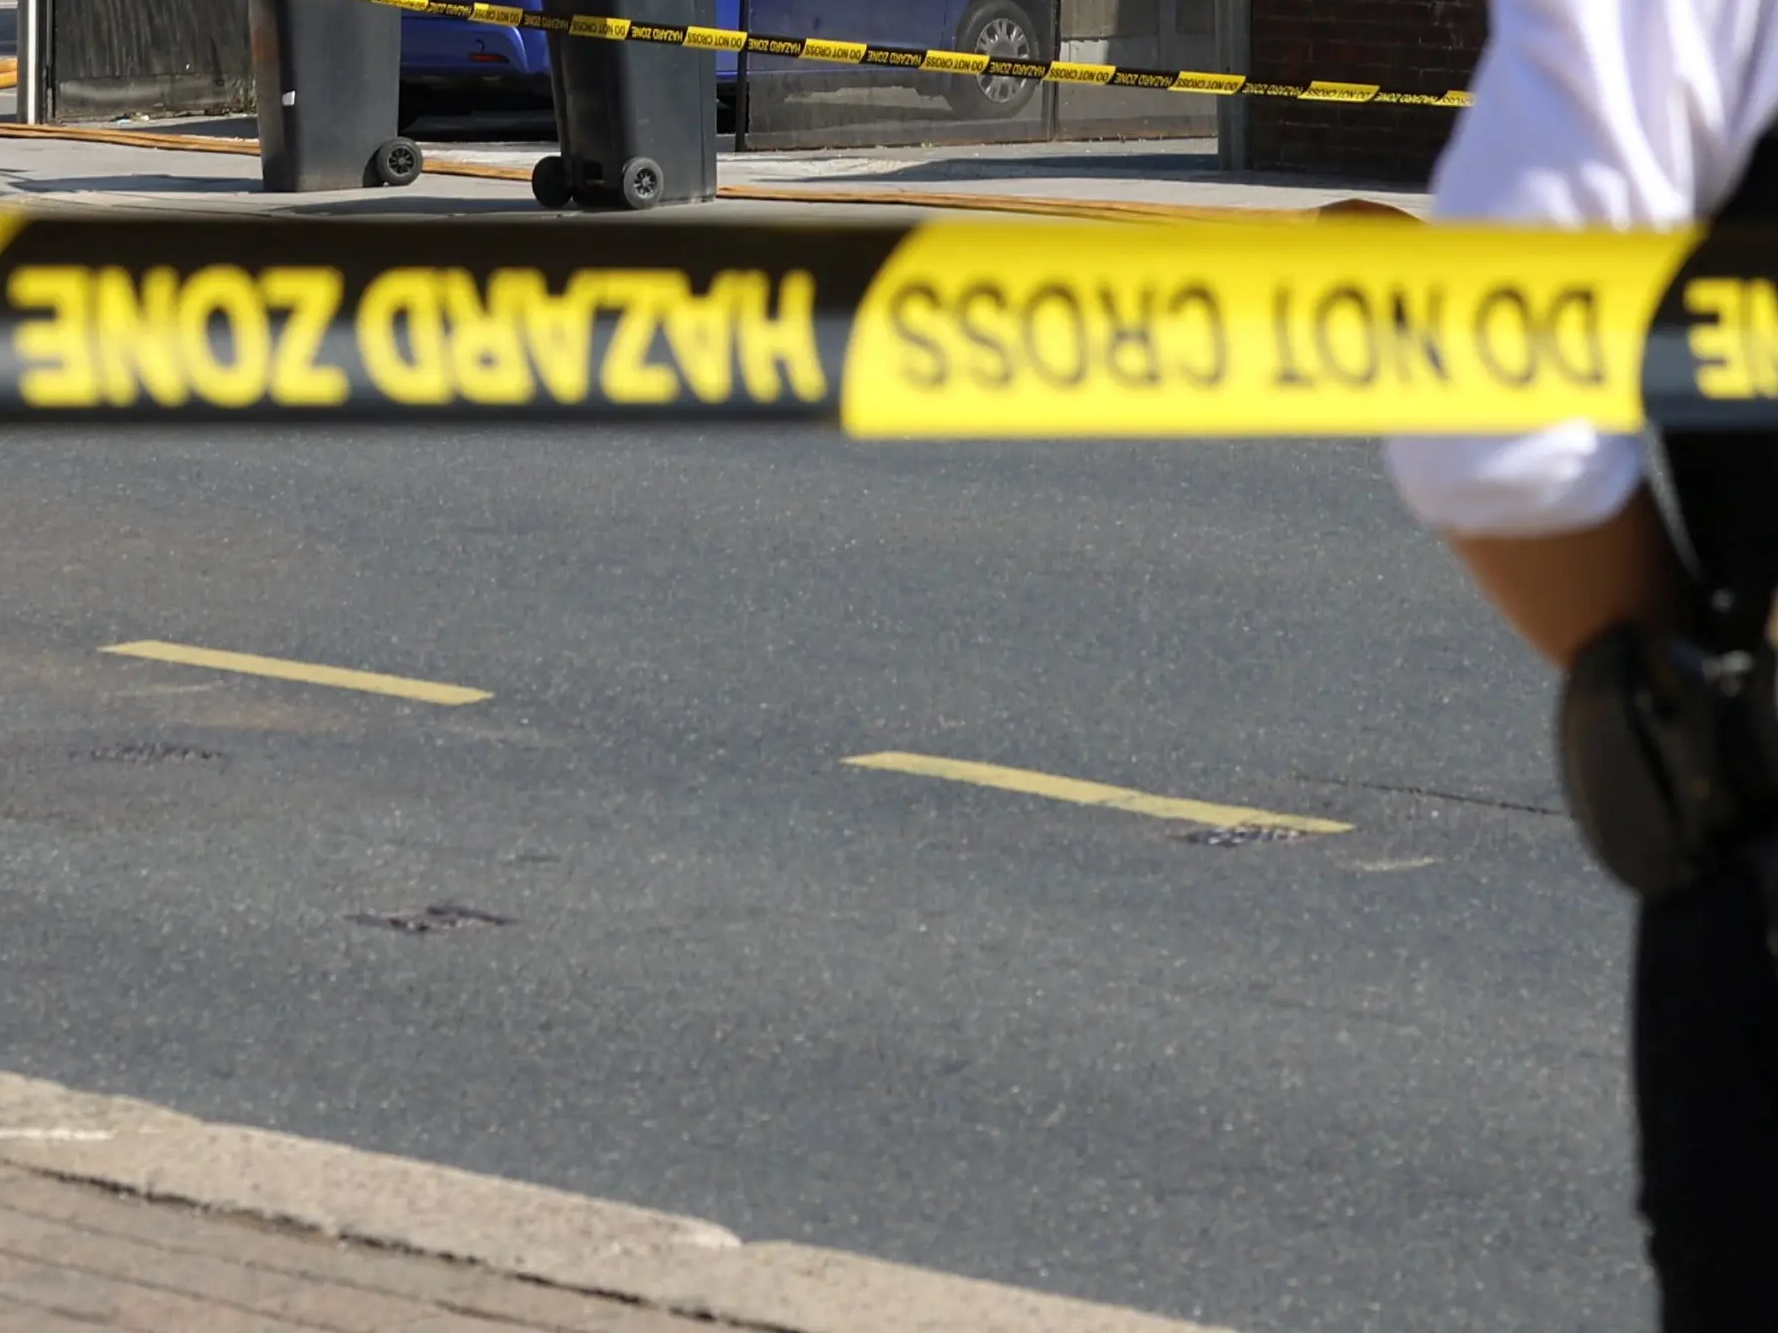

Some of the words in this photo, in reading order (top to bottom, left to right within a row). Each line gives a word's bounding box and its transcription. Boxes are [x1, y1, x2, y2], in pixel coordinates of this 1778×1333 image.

[524, 15, 541, 26] ZONE
[542, 17, 569, 29] HAZARD
[572, 20, 598, 32] CROSS
[599, 23, 614, 34] NOT
[615, 24, 626, 35] DO
[632, 26, 652, 39] ZONE
[652, 28, 683, 42] HAZARD
[687, 32, 714, 45] CROSS
[714, 34, 729, 47] NOT
[729, 37, 742, 48] DO
[748, 38, 769, 51] ZONE
[769, 40, 801, 54] HAZARD
[805, 44, 831, 57] CROSS
[831, 46, 848, 58] NOT
[849, 48, 861, 59] DO
[868, 50, 890, 63] ZONE
[889, 52, 921, 66] HAZARD
[925, 55, 953, 68] CROSS
[953, 58, 970, 70] NOT
[971, 60, 983, 71] DO
[989, 61, 1012, 74] ZONE
[1012, 63, 1045, 78] HAZARD
[1050, 67, 1077, 79] CROSS
[1078, 69, 1095, 81] NOT
[1096, 72, 1109, 81] DO
[1116, 72, 1138, 84] ZONE
[1138, 74, 1172, 88] HAZARD
[1243, 82, 1267, 94] ZONE
[1267, 84, 1303, 98] HAZARD
[7, 264, 350, 408] ZONE
[355, 266, 827, 407] HAZARD
[887, 277, 1229, 393] CROSS
[1271, 280, 1451, 390] NOT
[1475, 285, 1609, 390] DO
